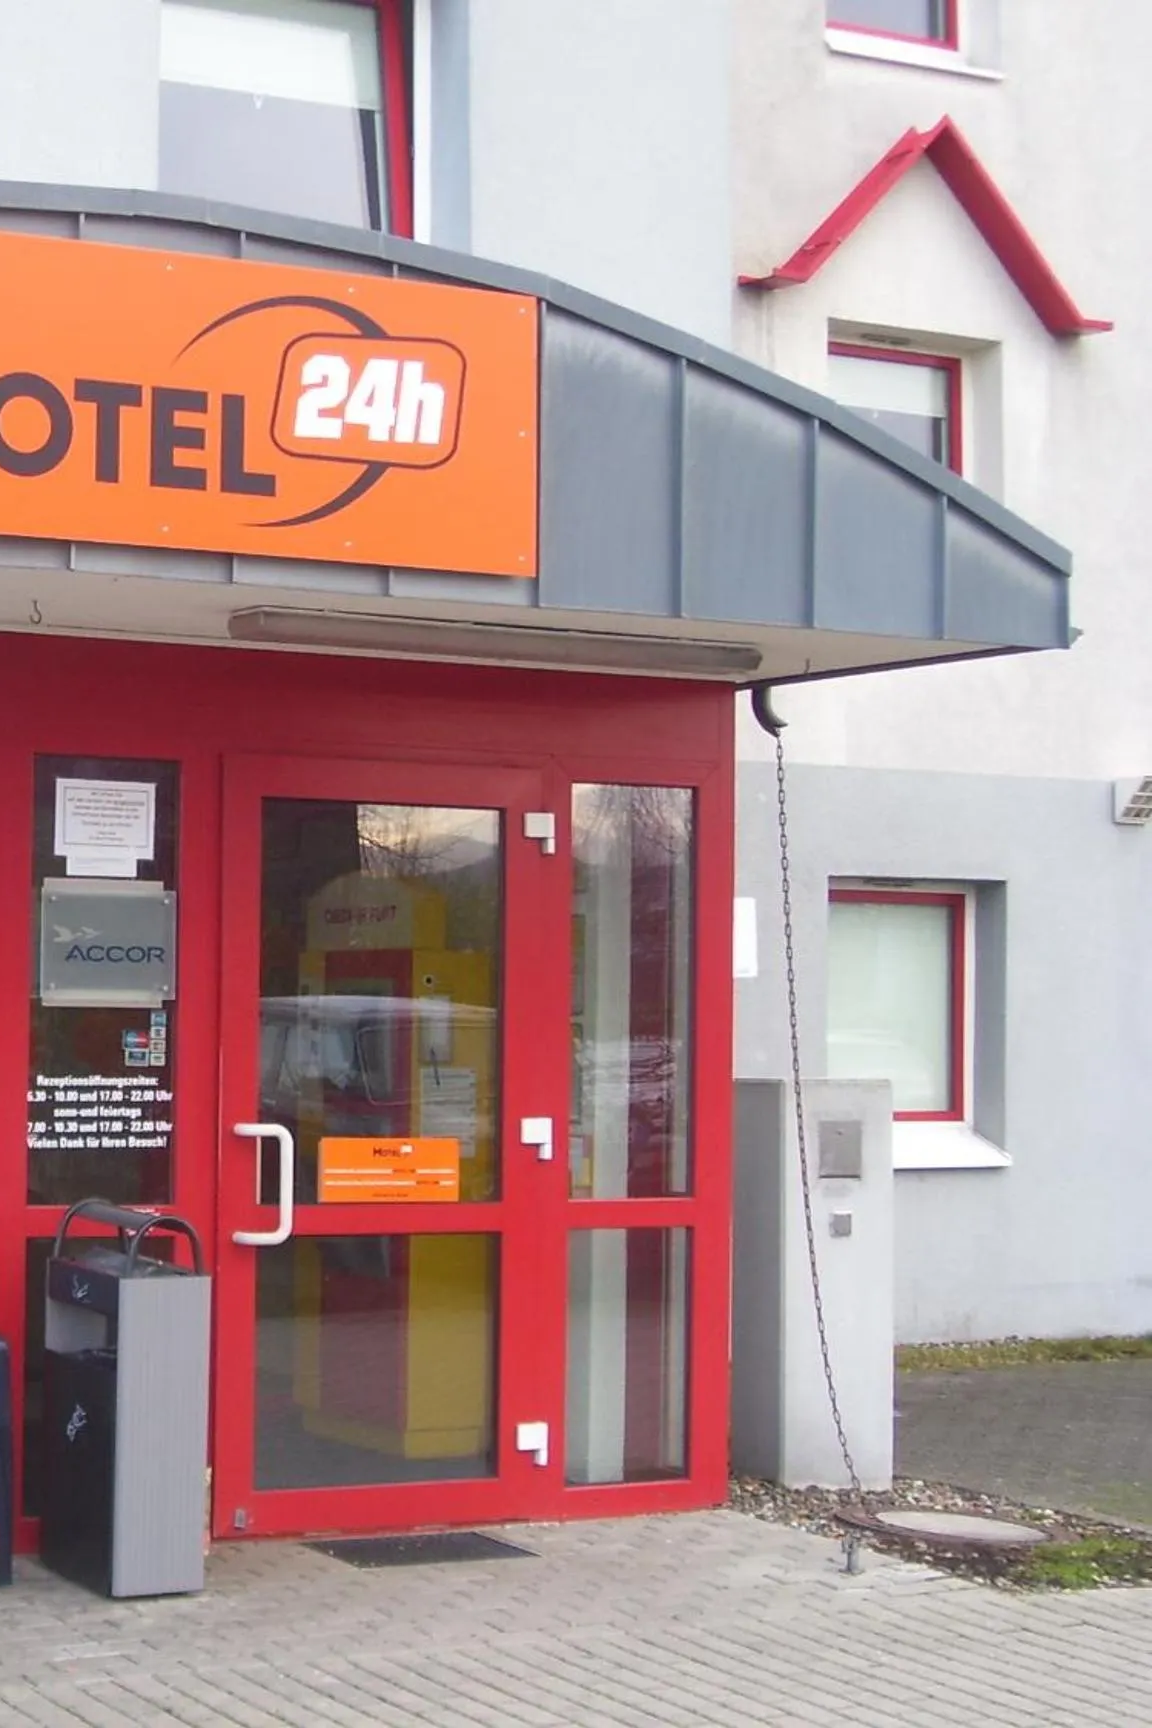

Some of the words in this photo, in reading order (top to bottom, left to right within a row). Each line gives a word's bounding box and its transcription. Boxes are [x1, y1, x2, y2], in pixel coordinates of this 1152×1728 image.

[293, 352, 446, 446] 24h
[64, 944, 167, 964] ACCOR
[79, 1091, 97, 1102] und
[156, 1090, 173, 1102] Uhr
[99, 1105, 142, 1119] feiertags
[79, 1121, 97, 1133] und
[156, 1121, 173, 1132] Uhr
[27, 1136, 58, 1148] Vielen
[59, 1136, 85, 1148] Dank
[86, 1136, 99, 1148] für
[101, 1136, 127, 1148] Ihren
[128, 1136, 167, 1148] Besuch!
